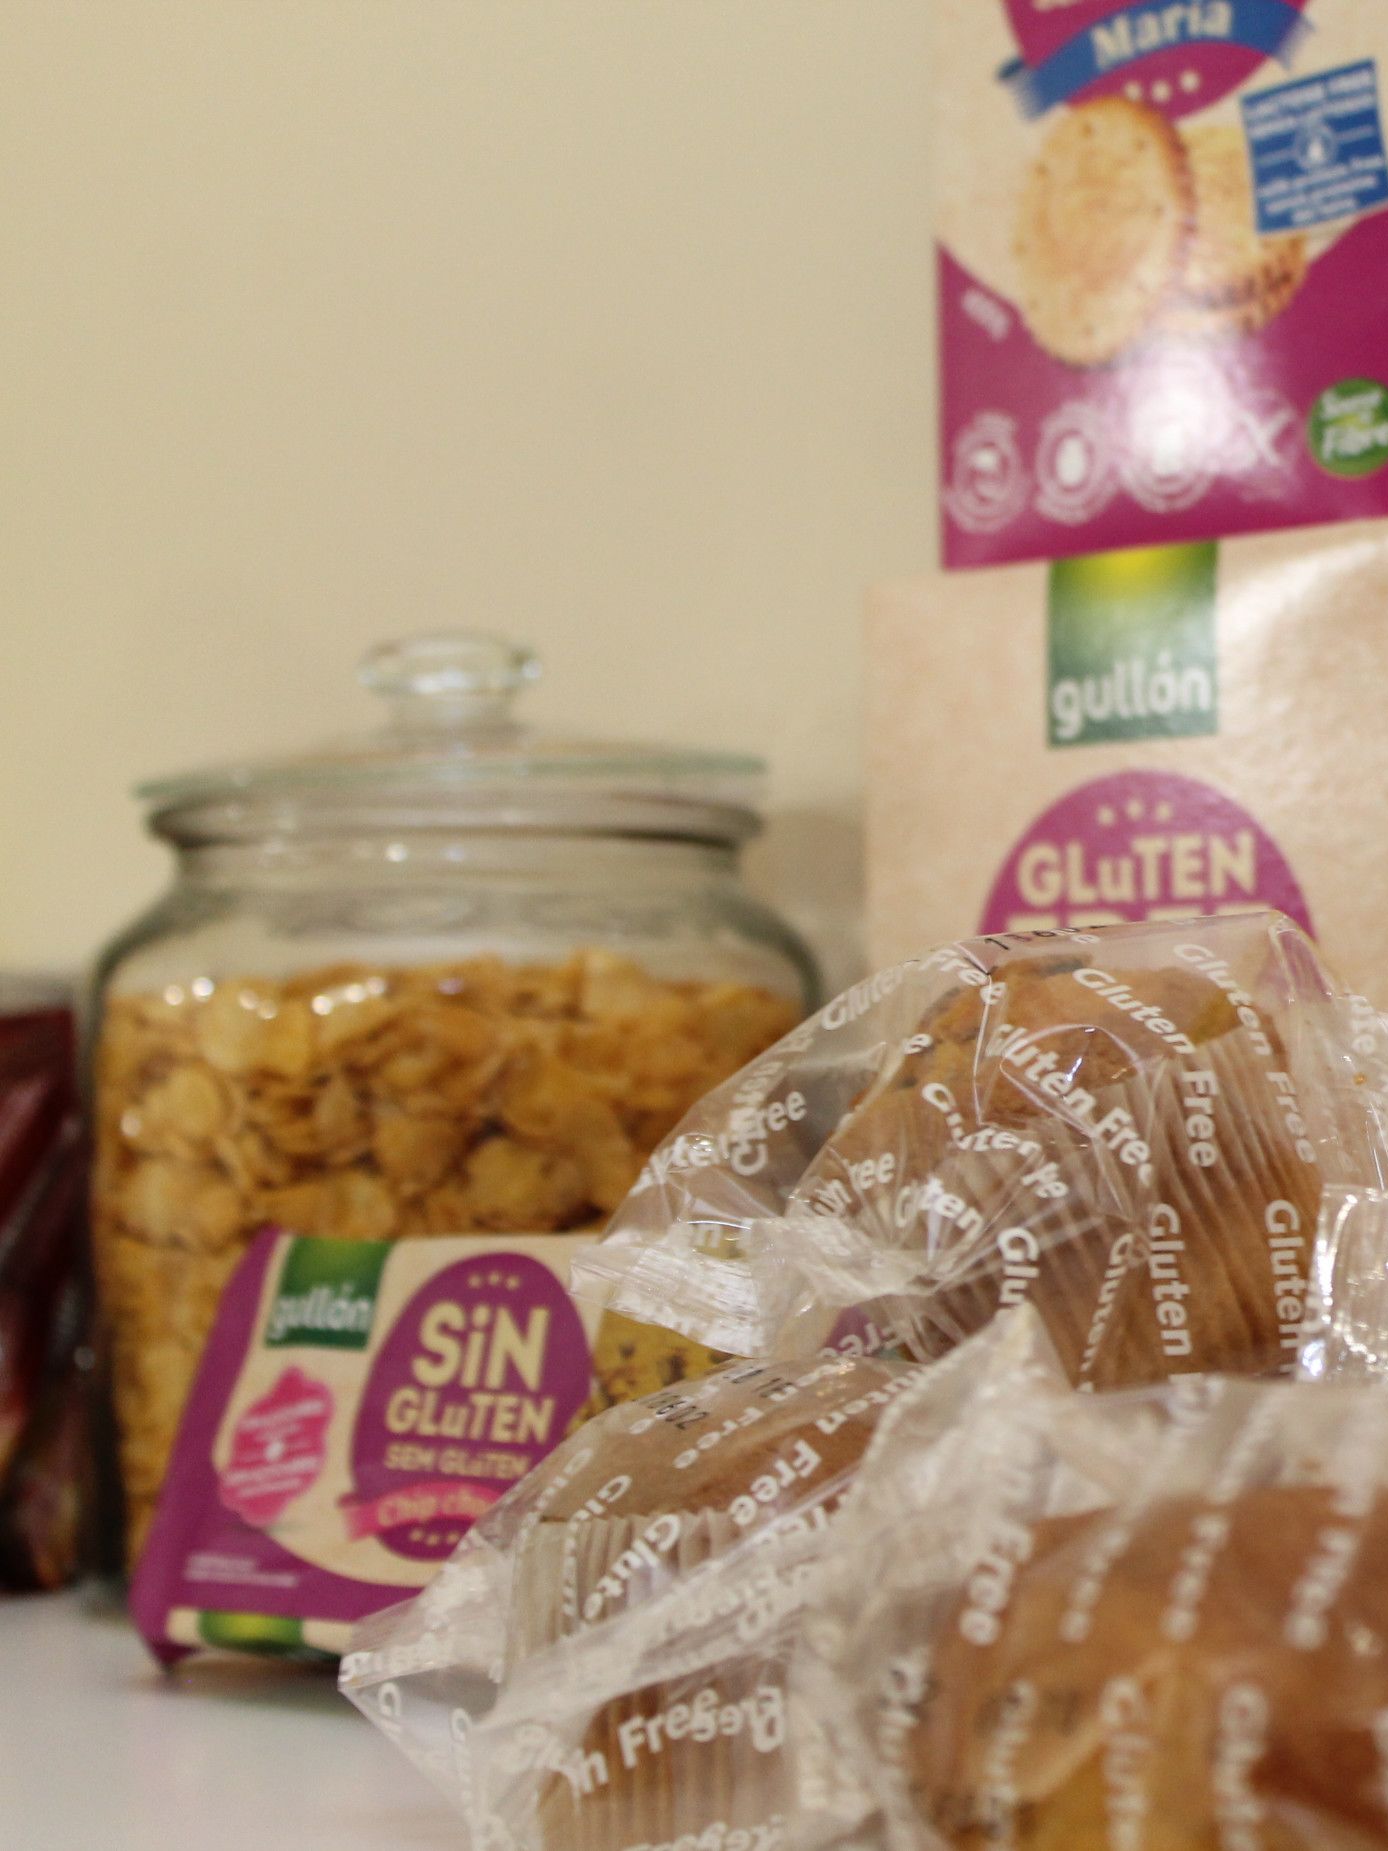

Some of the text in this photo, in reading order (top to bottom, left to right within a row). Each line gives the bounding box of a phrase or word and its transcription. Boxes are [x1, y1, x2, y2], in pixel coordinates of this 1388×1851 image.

[1050, 648, 1214, 738] gullón
[1073, 967, 1219, 1357] Gluten Free Gluten
[998, 1226, 1041, 1305] Glu
[729, 1438, 822, 1527] Free
[581, 1513, 682, 1619] Glute
